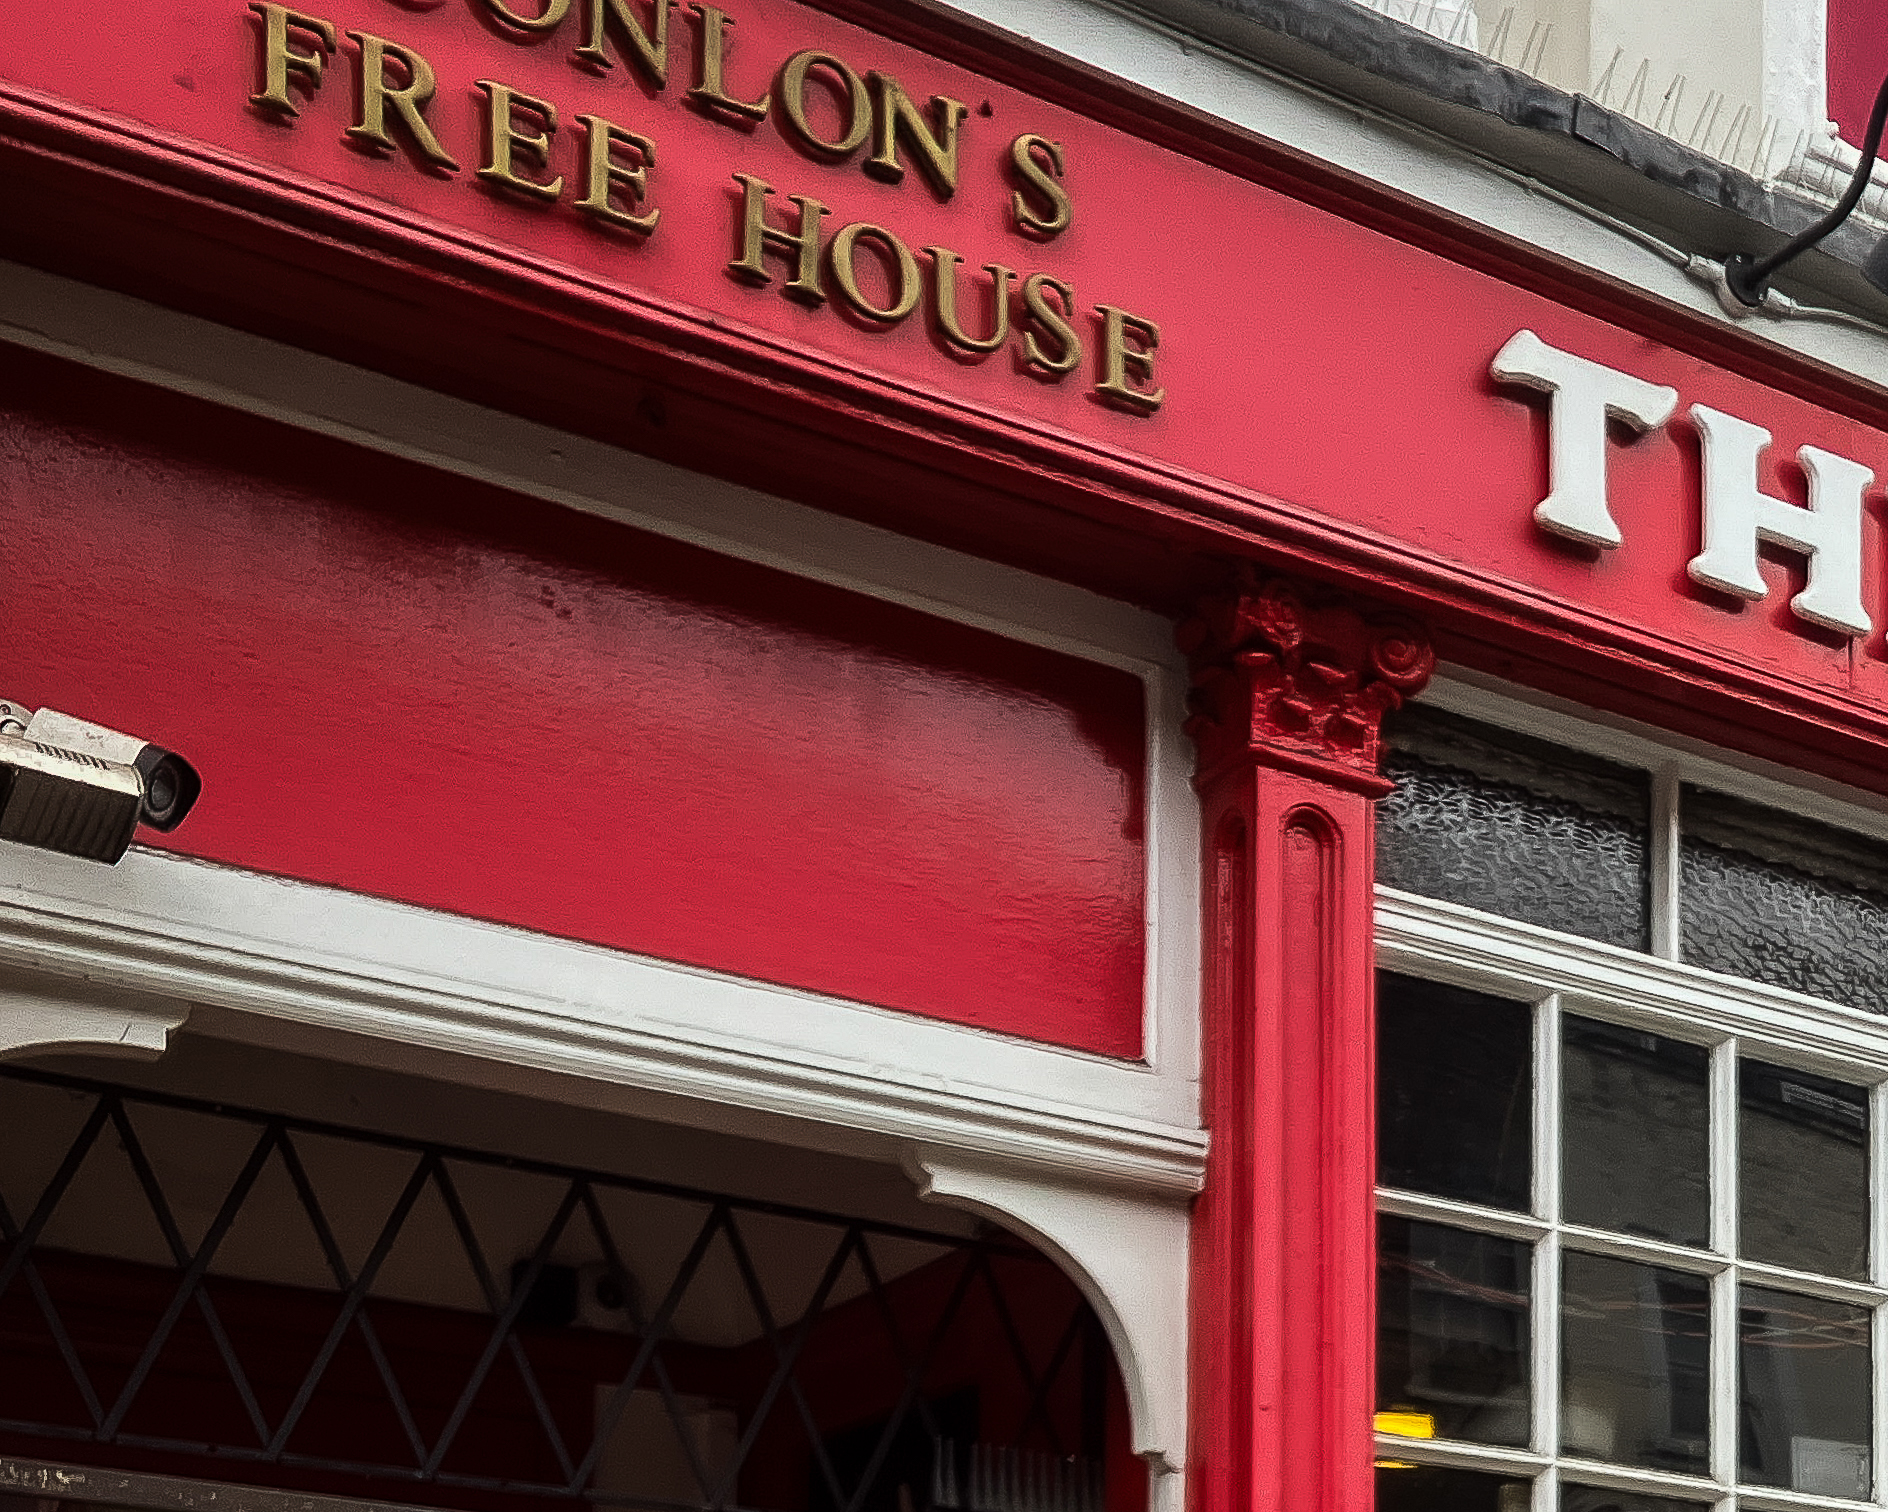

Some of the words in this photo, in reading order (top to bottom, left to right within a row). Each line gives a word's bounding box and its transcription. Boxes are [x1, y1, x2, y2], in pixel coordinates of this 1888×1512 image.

[247, 1, 663, 237] FREE
[728, 172, 1166, 413] HOUSE
[395, 0, 1073, 237] NLON'S
